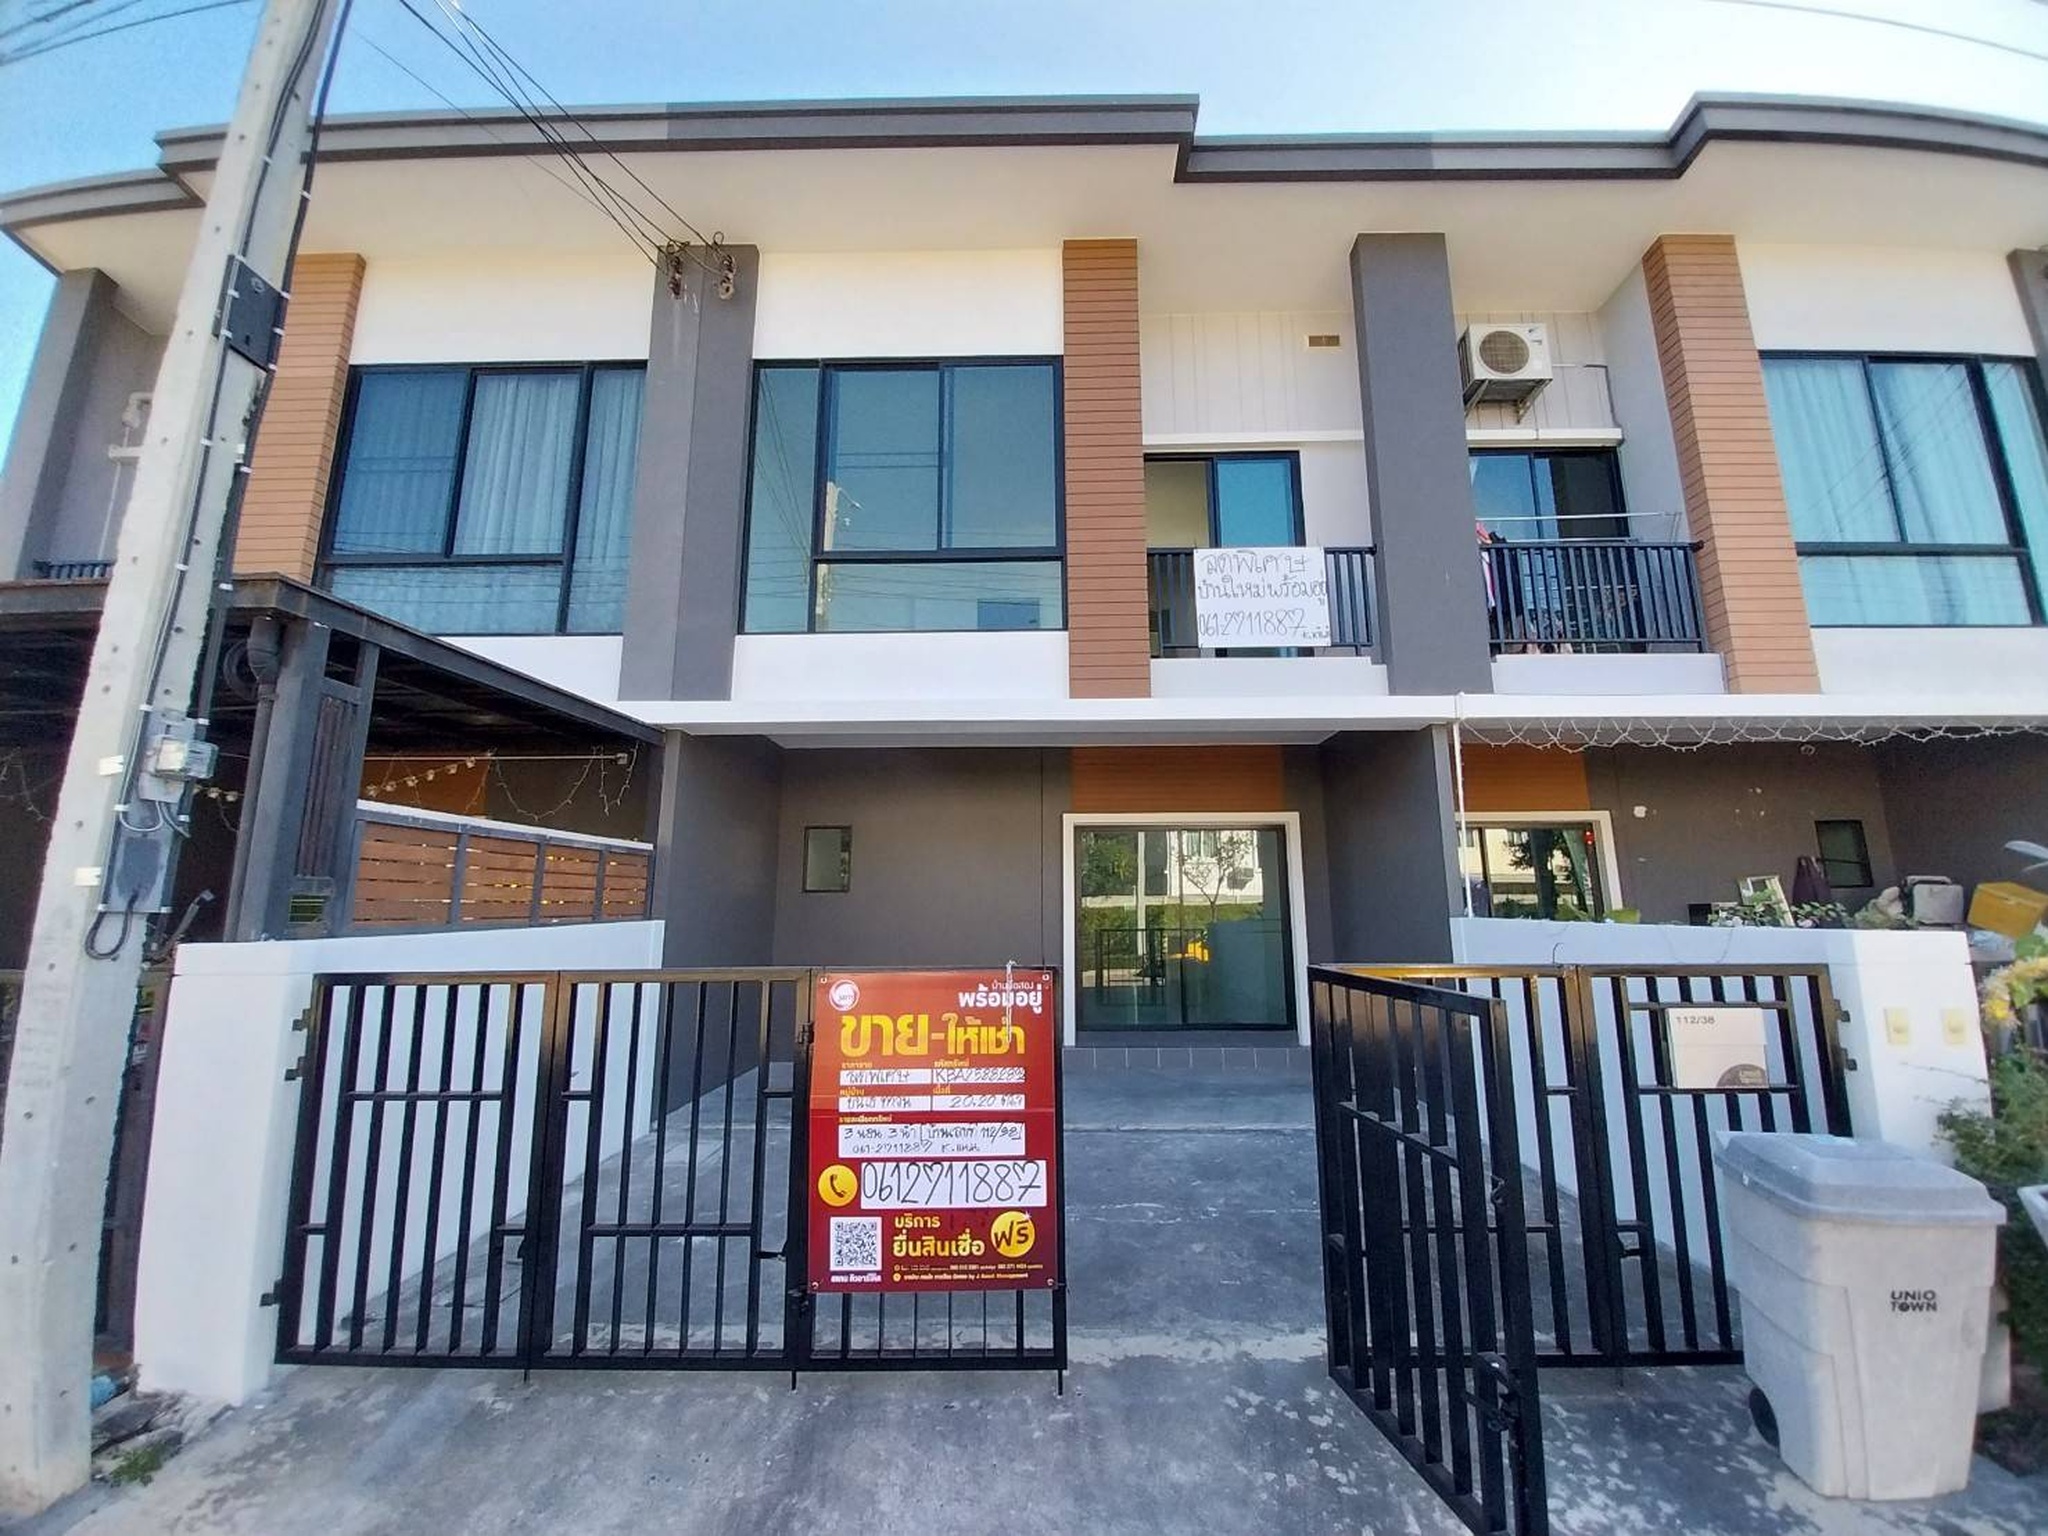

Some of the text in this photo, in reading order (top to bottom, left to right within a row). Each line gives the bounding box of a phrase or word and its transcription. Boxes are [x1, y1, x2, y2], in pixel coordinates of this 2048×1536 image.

[958, 983, 1042, 1013] พร้อมอยู่
[894, 1213, 941, 1228] บริการ
[892, 1229, 985, 1257] ยื่นสินเชื่อ
[993, 1220, 1030, 1250] ฟรี
[1891, 1289, 1937, 1301] UNIO
[1890, 1301, 1938, 1312] TOWN
